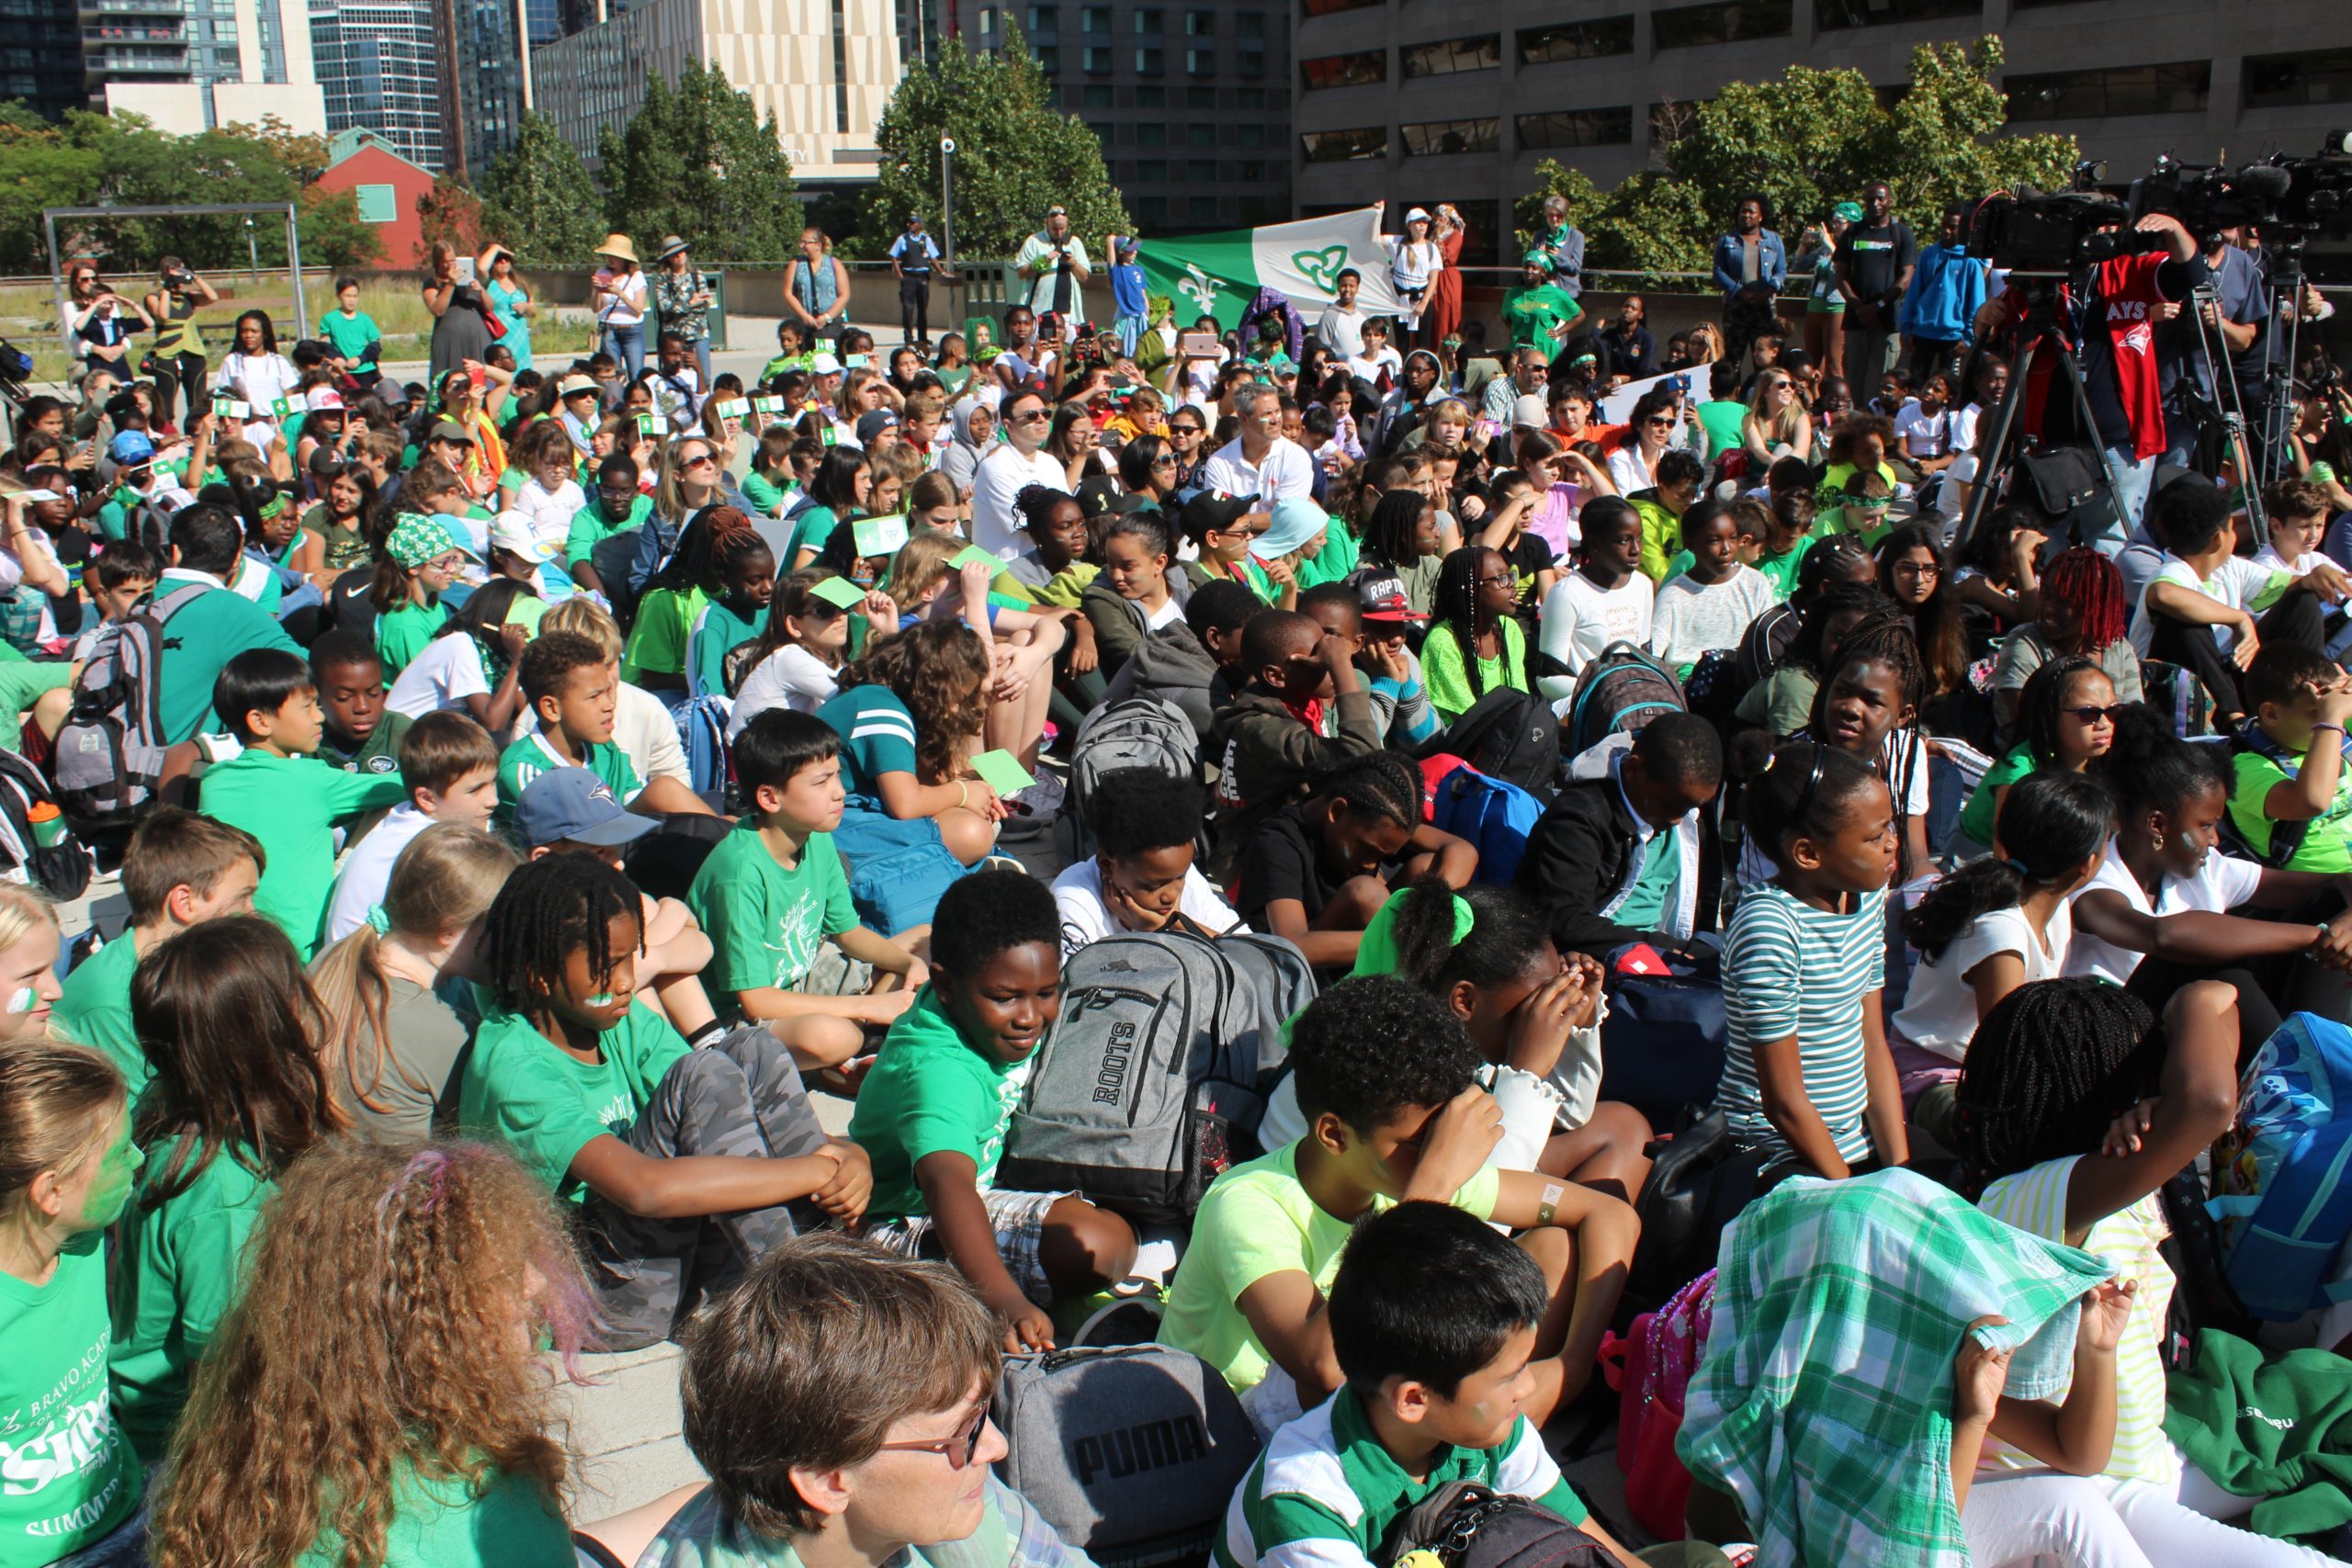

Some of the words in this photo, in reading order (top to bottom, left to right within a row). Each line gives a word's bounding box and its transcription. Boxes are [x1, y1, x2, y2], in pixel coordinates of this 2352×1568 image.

[1091, 1021, 1136, 1107] ROOTS
[30, 1367, 80, 1418] BRAVO
[1072, 1413, 1208, 1486] PUMA
